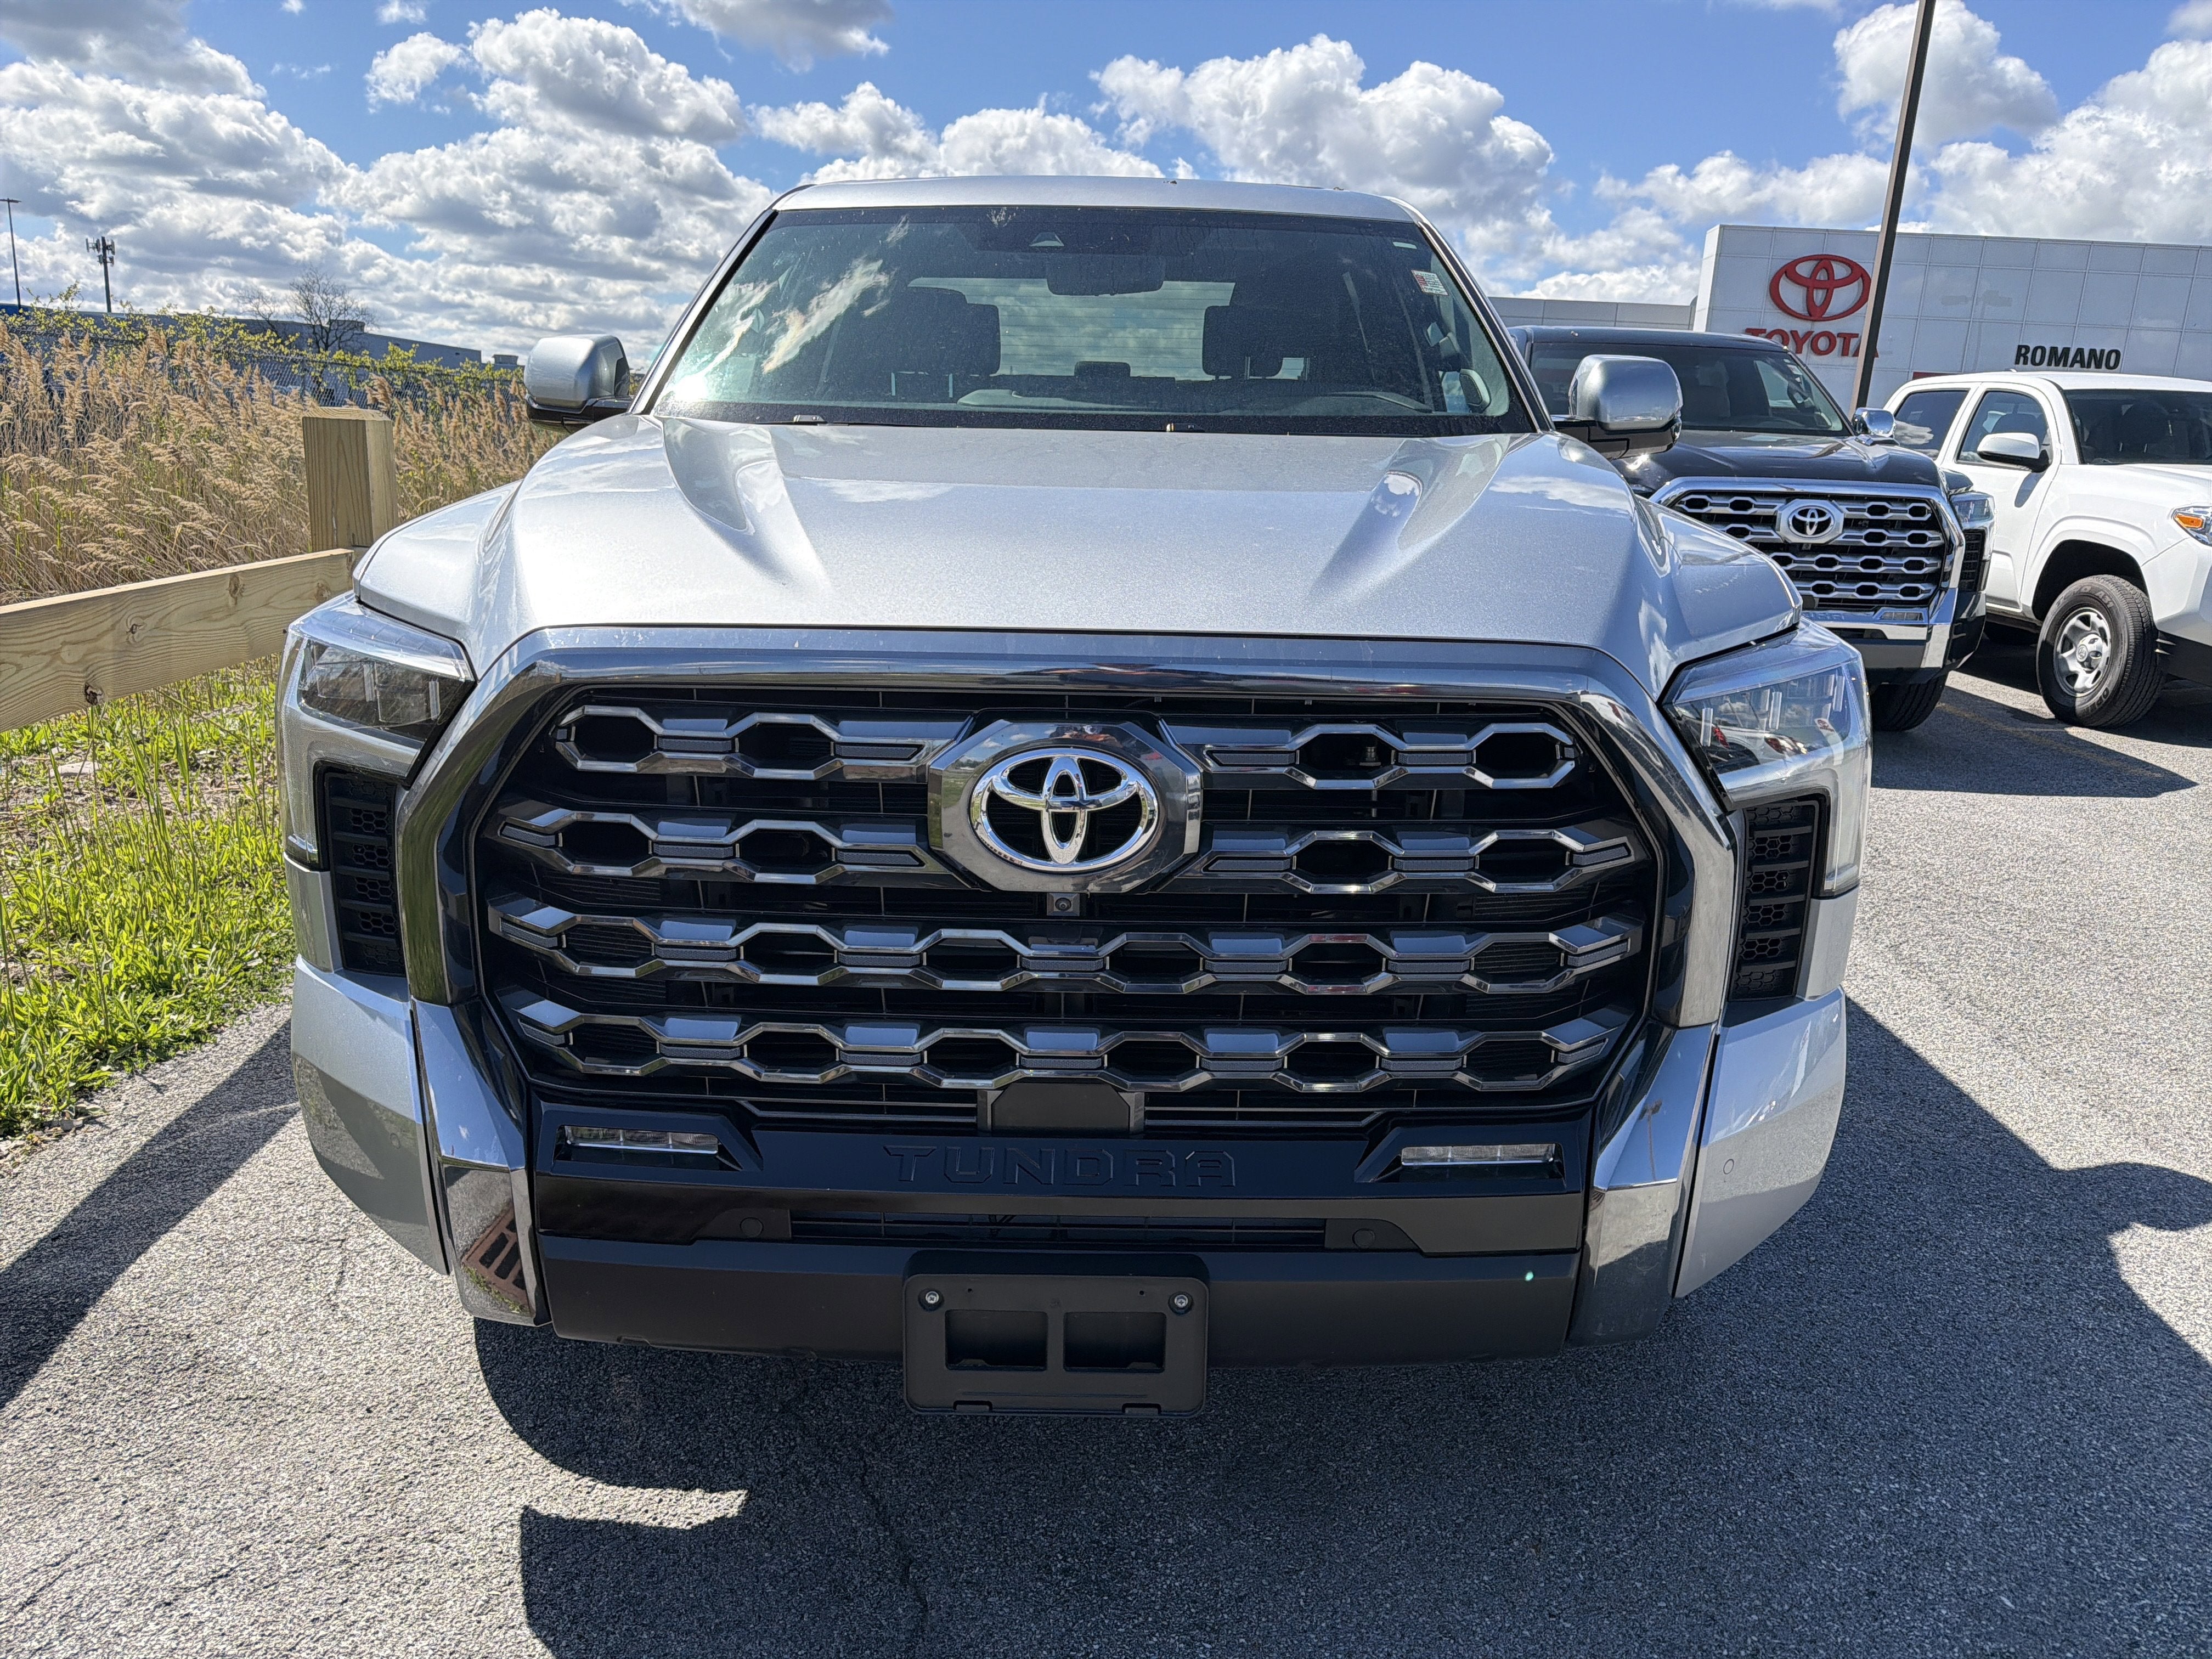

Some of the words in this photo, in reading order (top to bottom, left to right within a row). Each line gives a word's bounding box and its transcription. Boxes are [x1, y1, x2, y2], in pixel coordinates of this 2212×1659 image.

[1745, 328, 1879, 358] TOYOT
[2015, 345, 2121, 370] ROMANO
[883, 1145, 1235, 1187] TUNDRA
